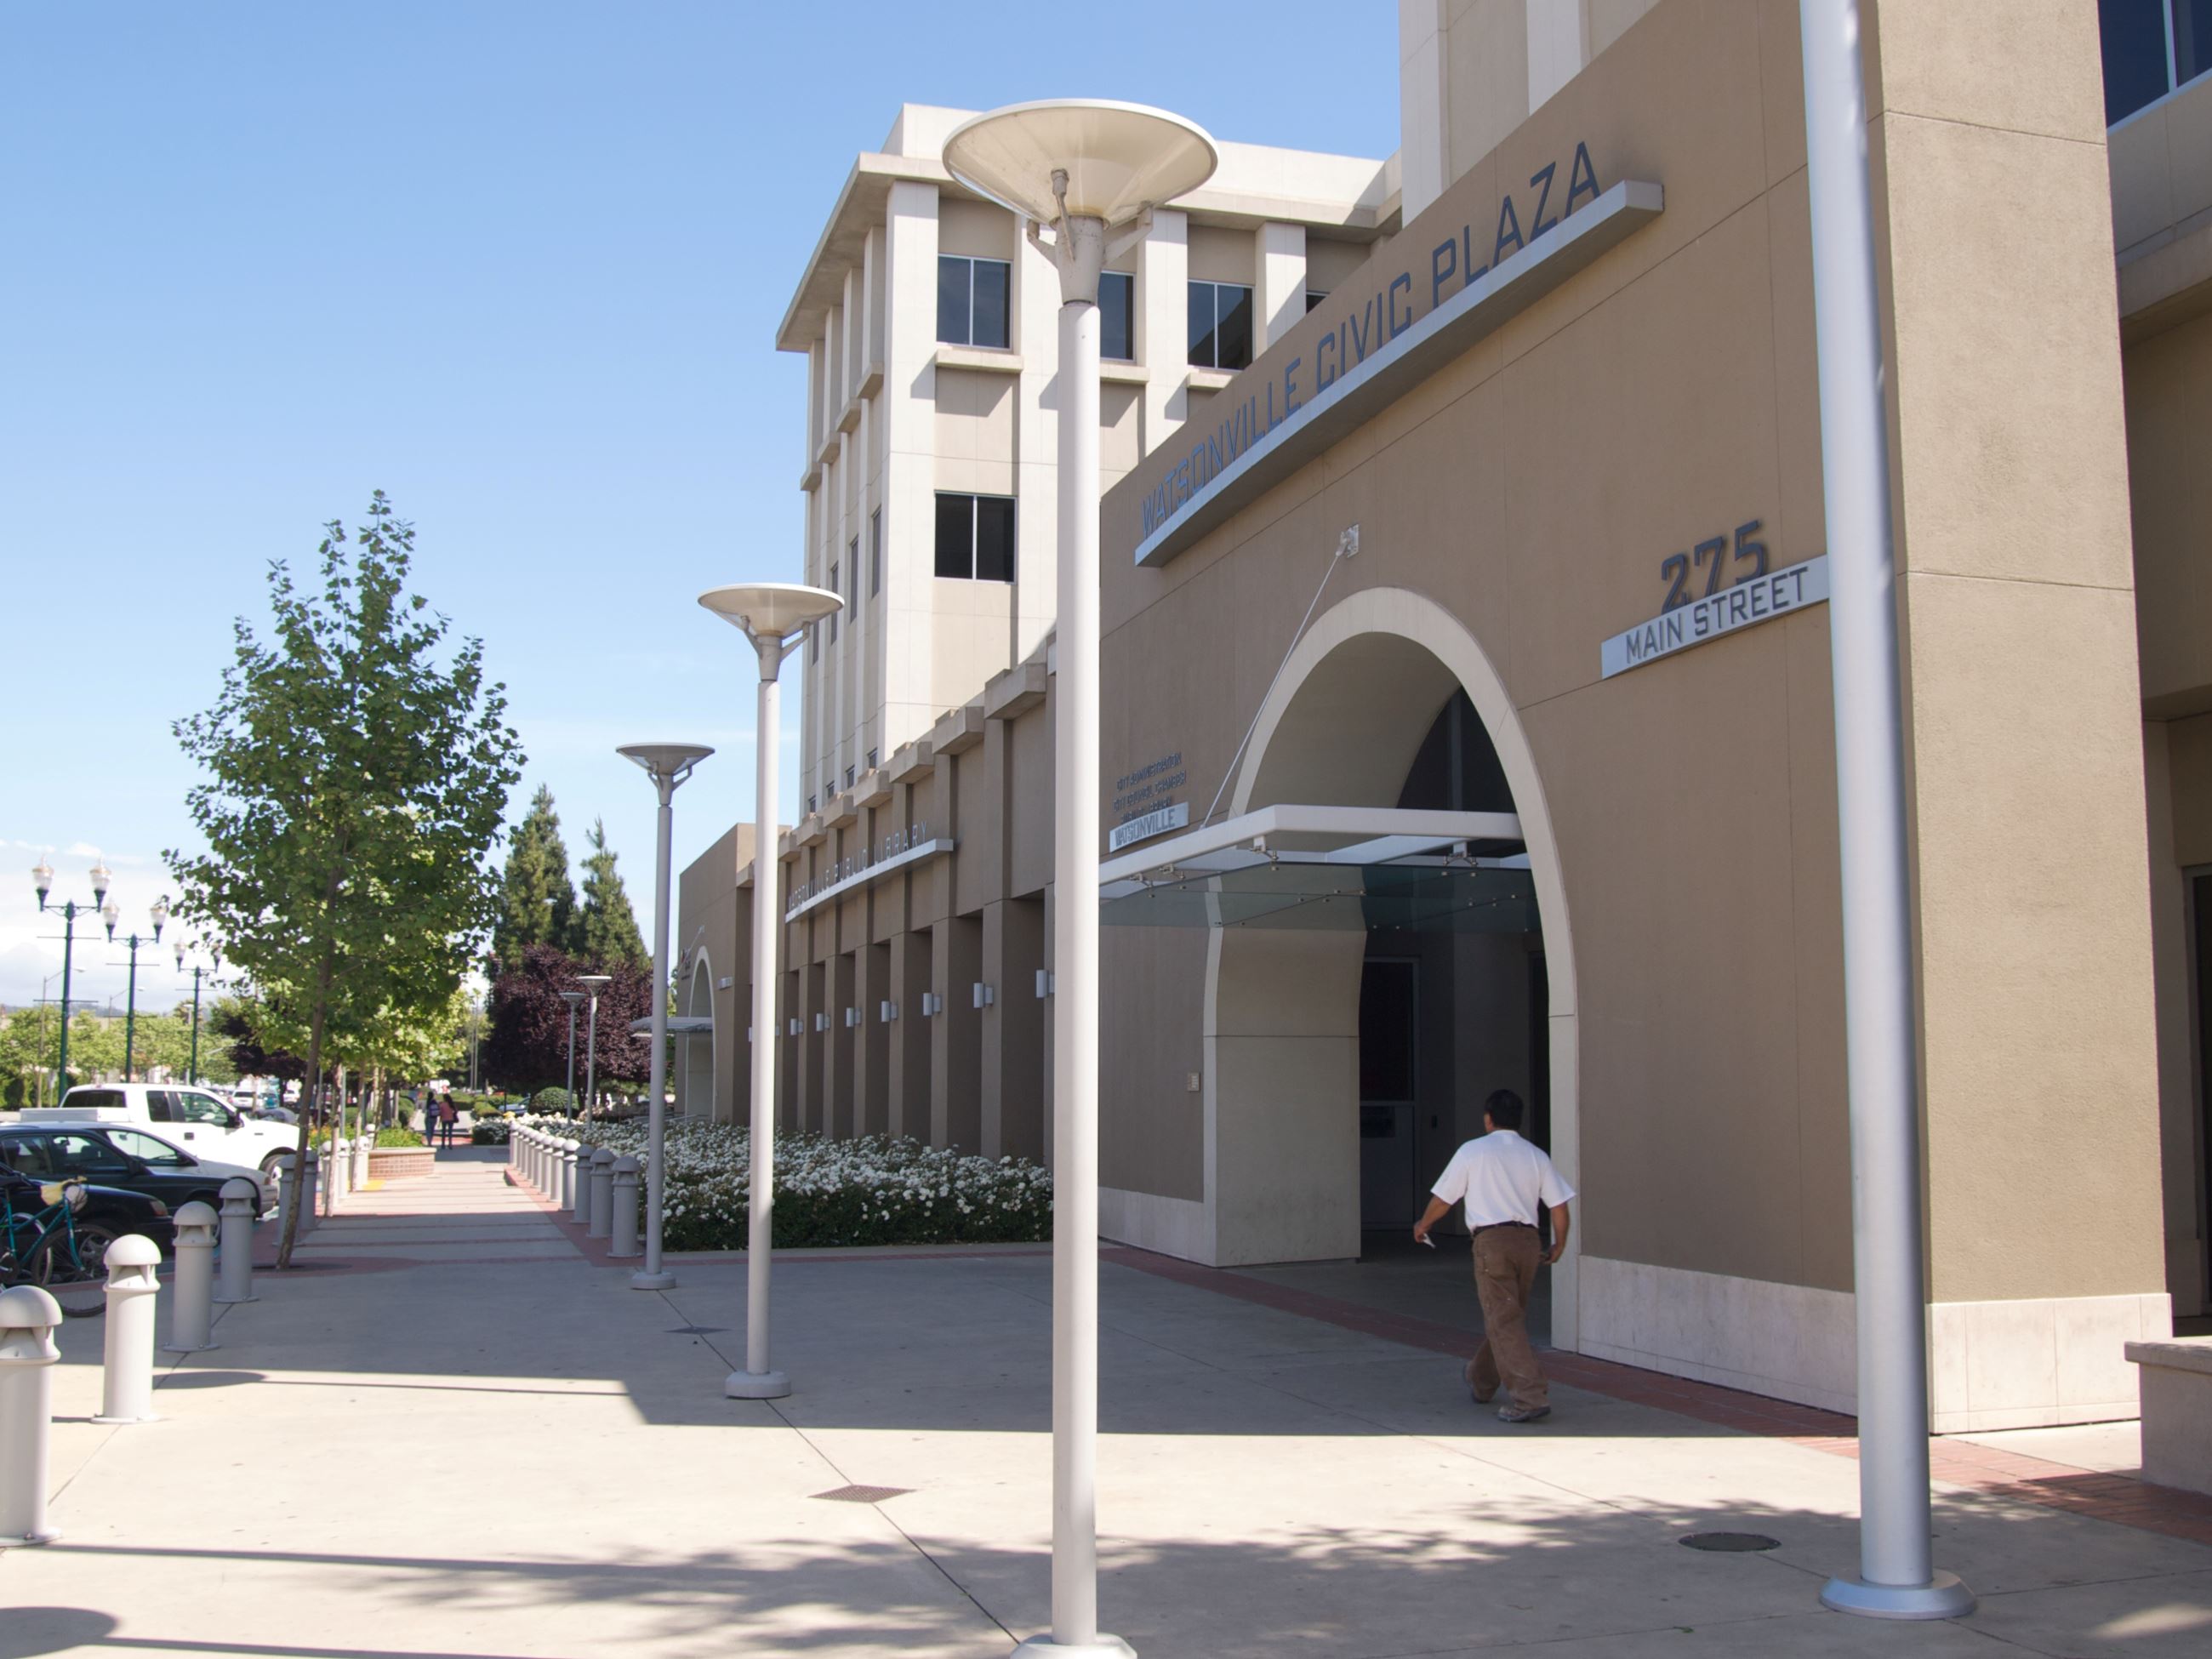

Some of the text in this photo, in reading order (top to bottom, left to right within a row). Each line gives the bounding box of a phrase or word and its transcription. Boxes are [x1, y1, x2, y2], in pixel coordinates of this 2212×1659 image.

[1142, 140, 1601, 539] WATSONVILLE CIVIC PLAZA
[1625, 566, 1808, 664] MAIN STREET
[1661, 519, 1768, 615] 275
[873, 821, 926, 866] LIBRARY
[1115, 807, 1176, 847] WATSONVILLE
